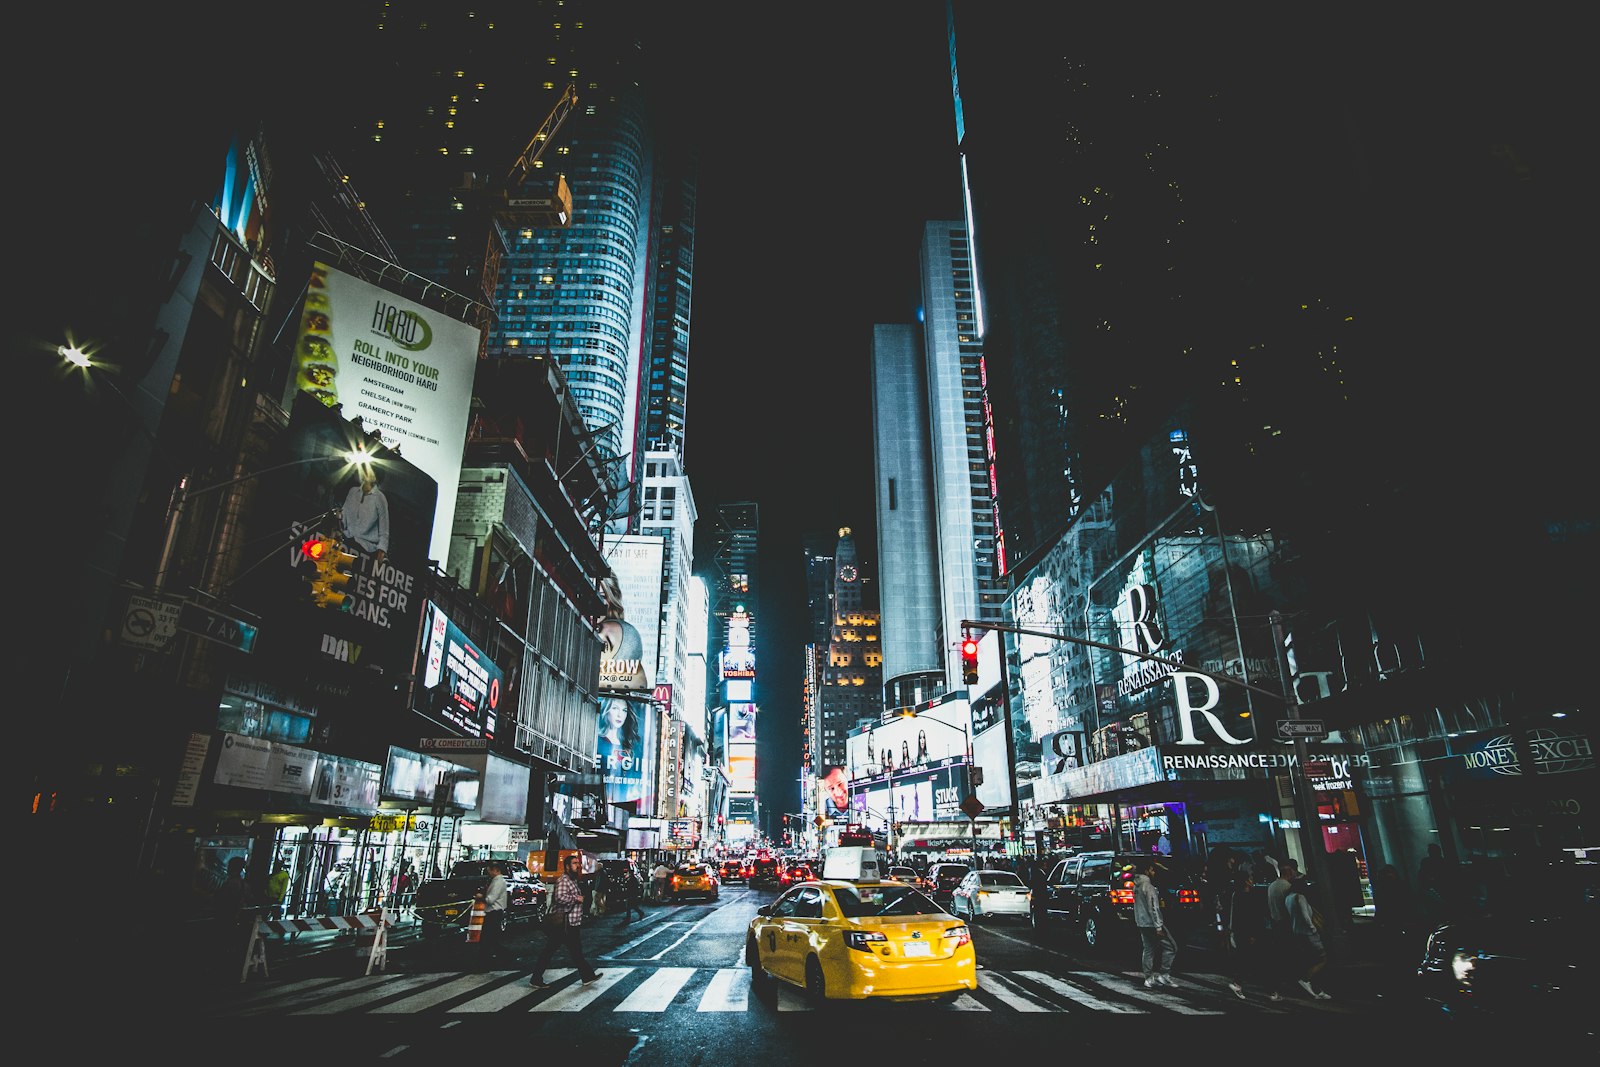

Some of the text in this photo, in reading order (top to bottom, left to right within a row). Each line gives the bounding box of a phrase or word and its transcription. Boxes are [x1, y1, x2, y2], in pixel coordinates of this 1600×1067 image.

[372, 300, 418, 343] HARU
[351, 352, 438, 392] NEIGHBORHOOD HARU
[353, 338, 440, 381] ROLL INTO YOUR
[360, 388, 391, 404] CHELSEA
[363, 376, 405, 396] AMSTERDAM
[358, 401, 413, 424] GRAMERCY PARK
[379, 421, 407, 435] KITCHEN
[633, 548, 648, 559] SAFE
[371, 559, 414, 595] MORE
[378, 584, 408, 614] FOR
[206, 615, 215, 632] 7
[1124, 584, 1164, 658] R
[1117, 648, 1184, 697] RENAISSANCE
[1167, 671, 1253, 745] R
[666, 726, 678, 797] PALACE
[1163, 754, 1269, 769] RENAISSANCE
[1463, 747, 1520, 770] MONEY
[1326, 779, 1346, 790] frozen
